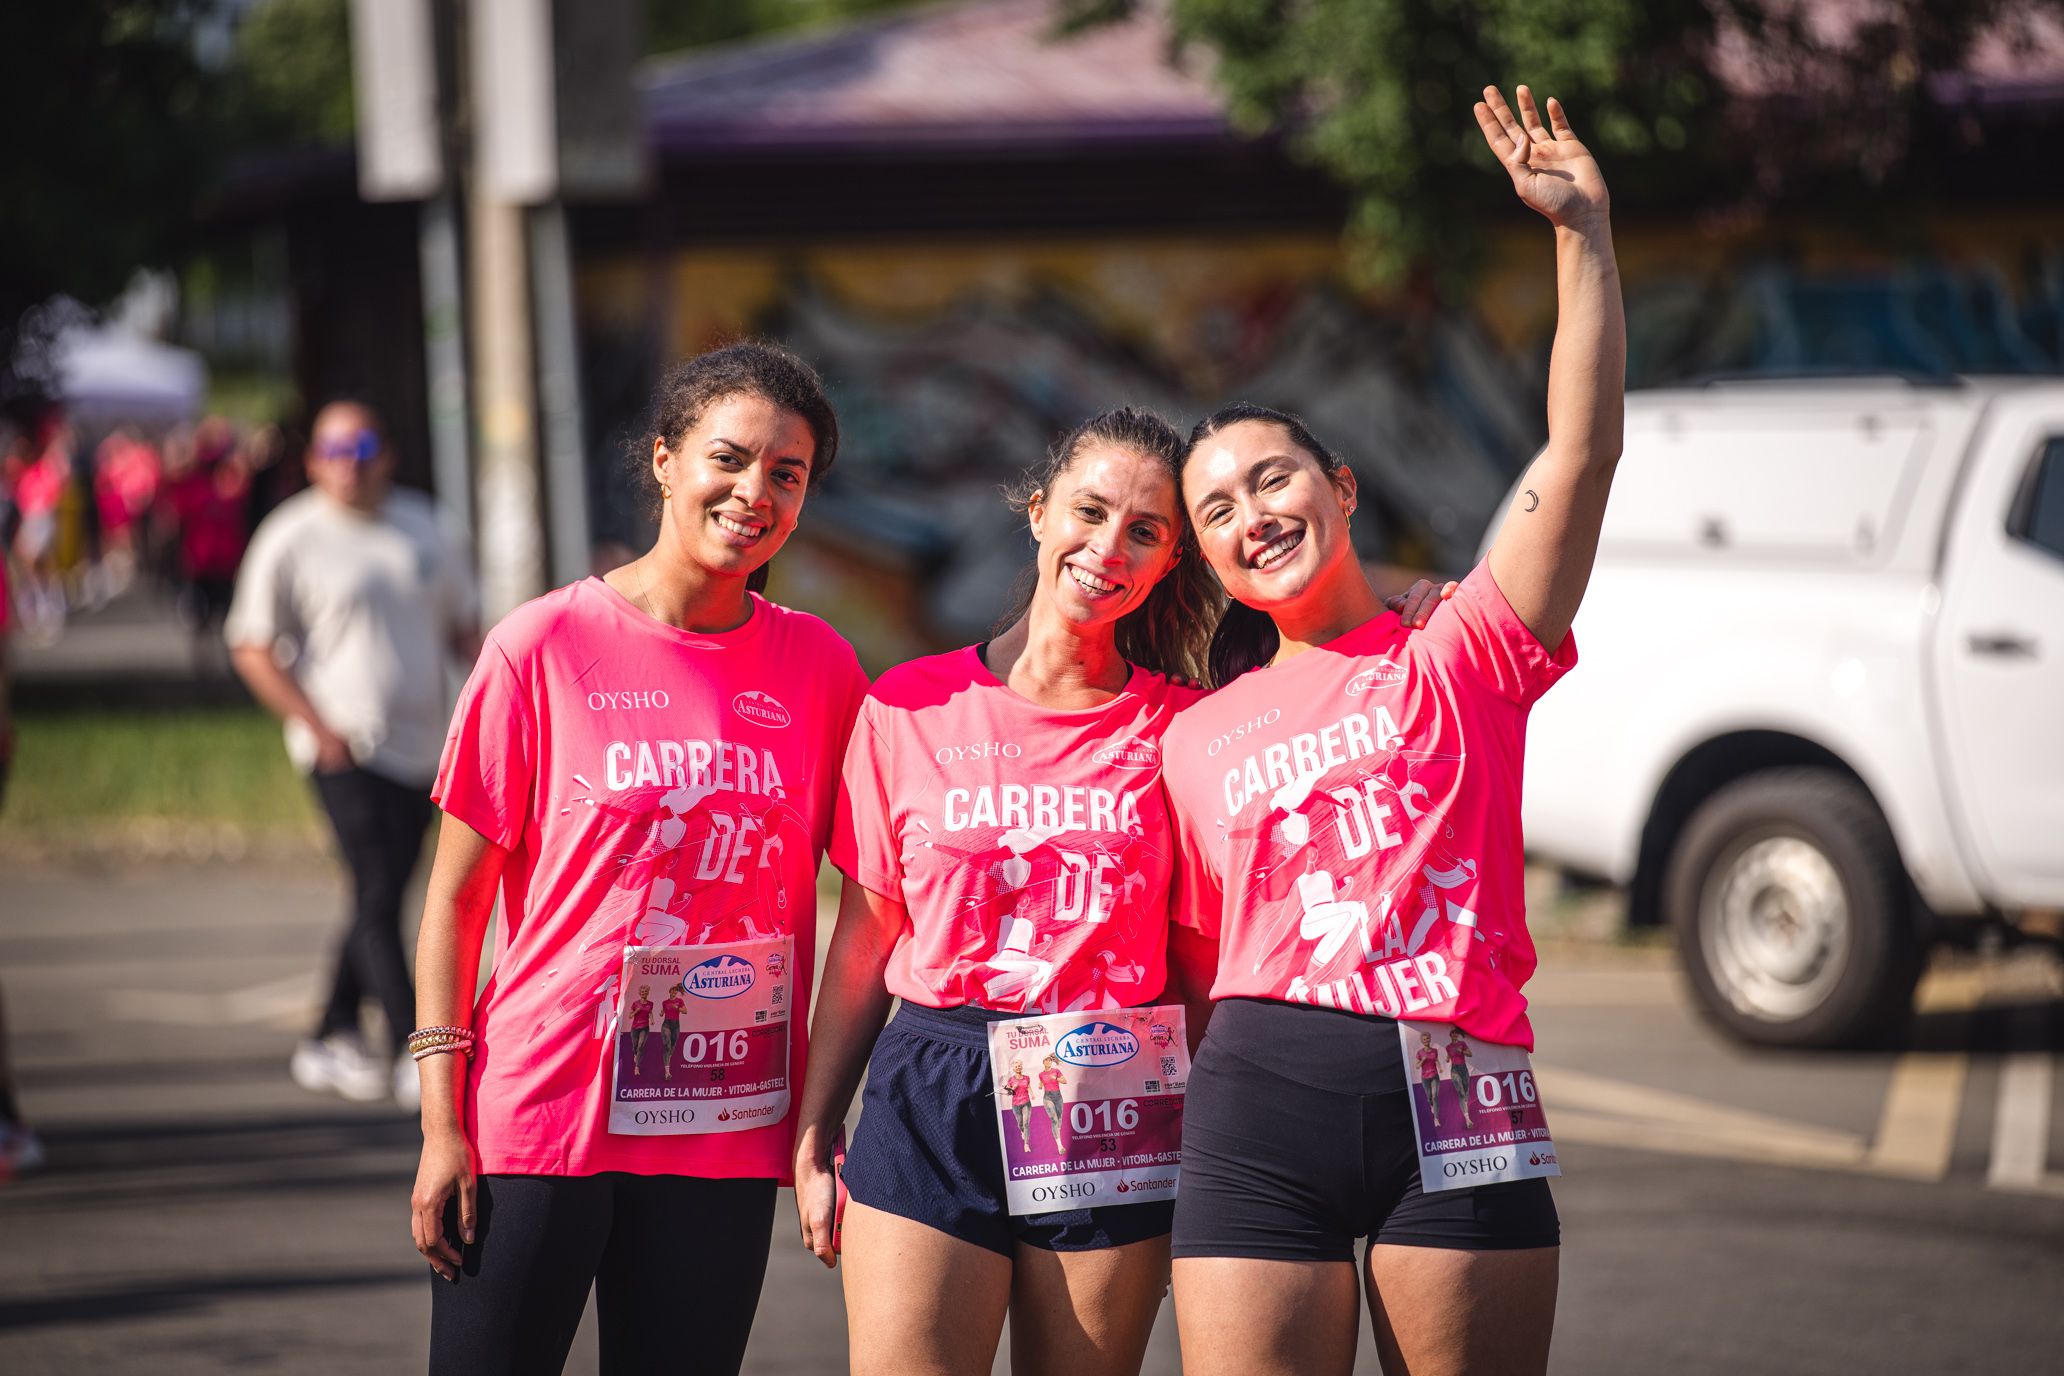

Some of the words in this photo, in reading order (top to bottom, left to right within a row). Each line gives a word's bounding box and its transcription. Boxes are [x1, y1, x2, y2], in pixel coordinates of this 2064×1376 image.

[587, 689, 670, 711] OYSHO
[738, 699, 787, 724] ASTURIANA
[1207, 708, 1281, 757] OYSHO
[935, 741, 1022, 765] OYSHO
[1099, 750, 1157, 765] ASTURIANA
[1224, 704, 1405, 817] CARRERA
[604, 738, 786, 800] CARRERA
[942, 783, 1145, 837] CARRERA
[1325, 773, 1403, 862] DE
[693, 809, 764, 885] DE
[1051, 848, 1122, 924] DE
[1358, 891, 1407, 964] LA
[641, 964, 681, 976] SUMA
[652, 956, 681, 964] DORSAL
[689, 973, 752, 990] ASTURIANA
[682, 1029, 749, 1063] 016
[1007, 1031, 1017, 1039] TU
[1010, 1035, 1051, 1050] SUMA
[1063, 1041, 1135, 1058] ASTURIANA
[710, 1068, 725, 1082] 58
[620, 1087, 662, 1099] CARRERA
[663, 1087, 676, 1098] DE
[678, 1087, 690, 1098] LA
[692, 1086, 723, 1097] MUJER
[729, 1077, 785, 1095] VITORIA-GASTEIZ
[1476, 1071, 1536, 1107] 016
[634, 1108, 695, 1125] OYSHO
[731, 1104, 775, 1120] Santander
[1070, 1098, 1139, 1134] 016
[1511, 1110, 1524, 1125] 57
[1100, 1138, 1116, 1152] 53
[1425, 1137, 1467, 1153] CARRERA
[1469, 1135, 1482, 1146] DE
[1483, 1132, 1496, 1145] LA
[1497, 1129, 1526, 1143] MUJER
[1012, 1162, 1058, 1177] CARRERA
[1061, 1160, 1072, 1171] DE
[1074, 1159, 1085, 1170] LA
[1087, 1157, 1115, 1169] MUJER
[1122, 1151, 1182, 1166] VITORIA-GASTE
[1443, 1155, 1508, 1178] OYSHO
[1032, 1181, 1096, 1202] OYSHO
[1131, 1177, 1176, 1192] Santander
